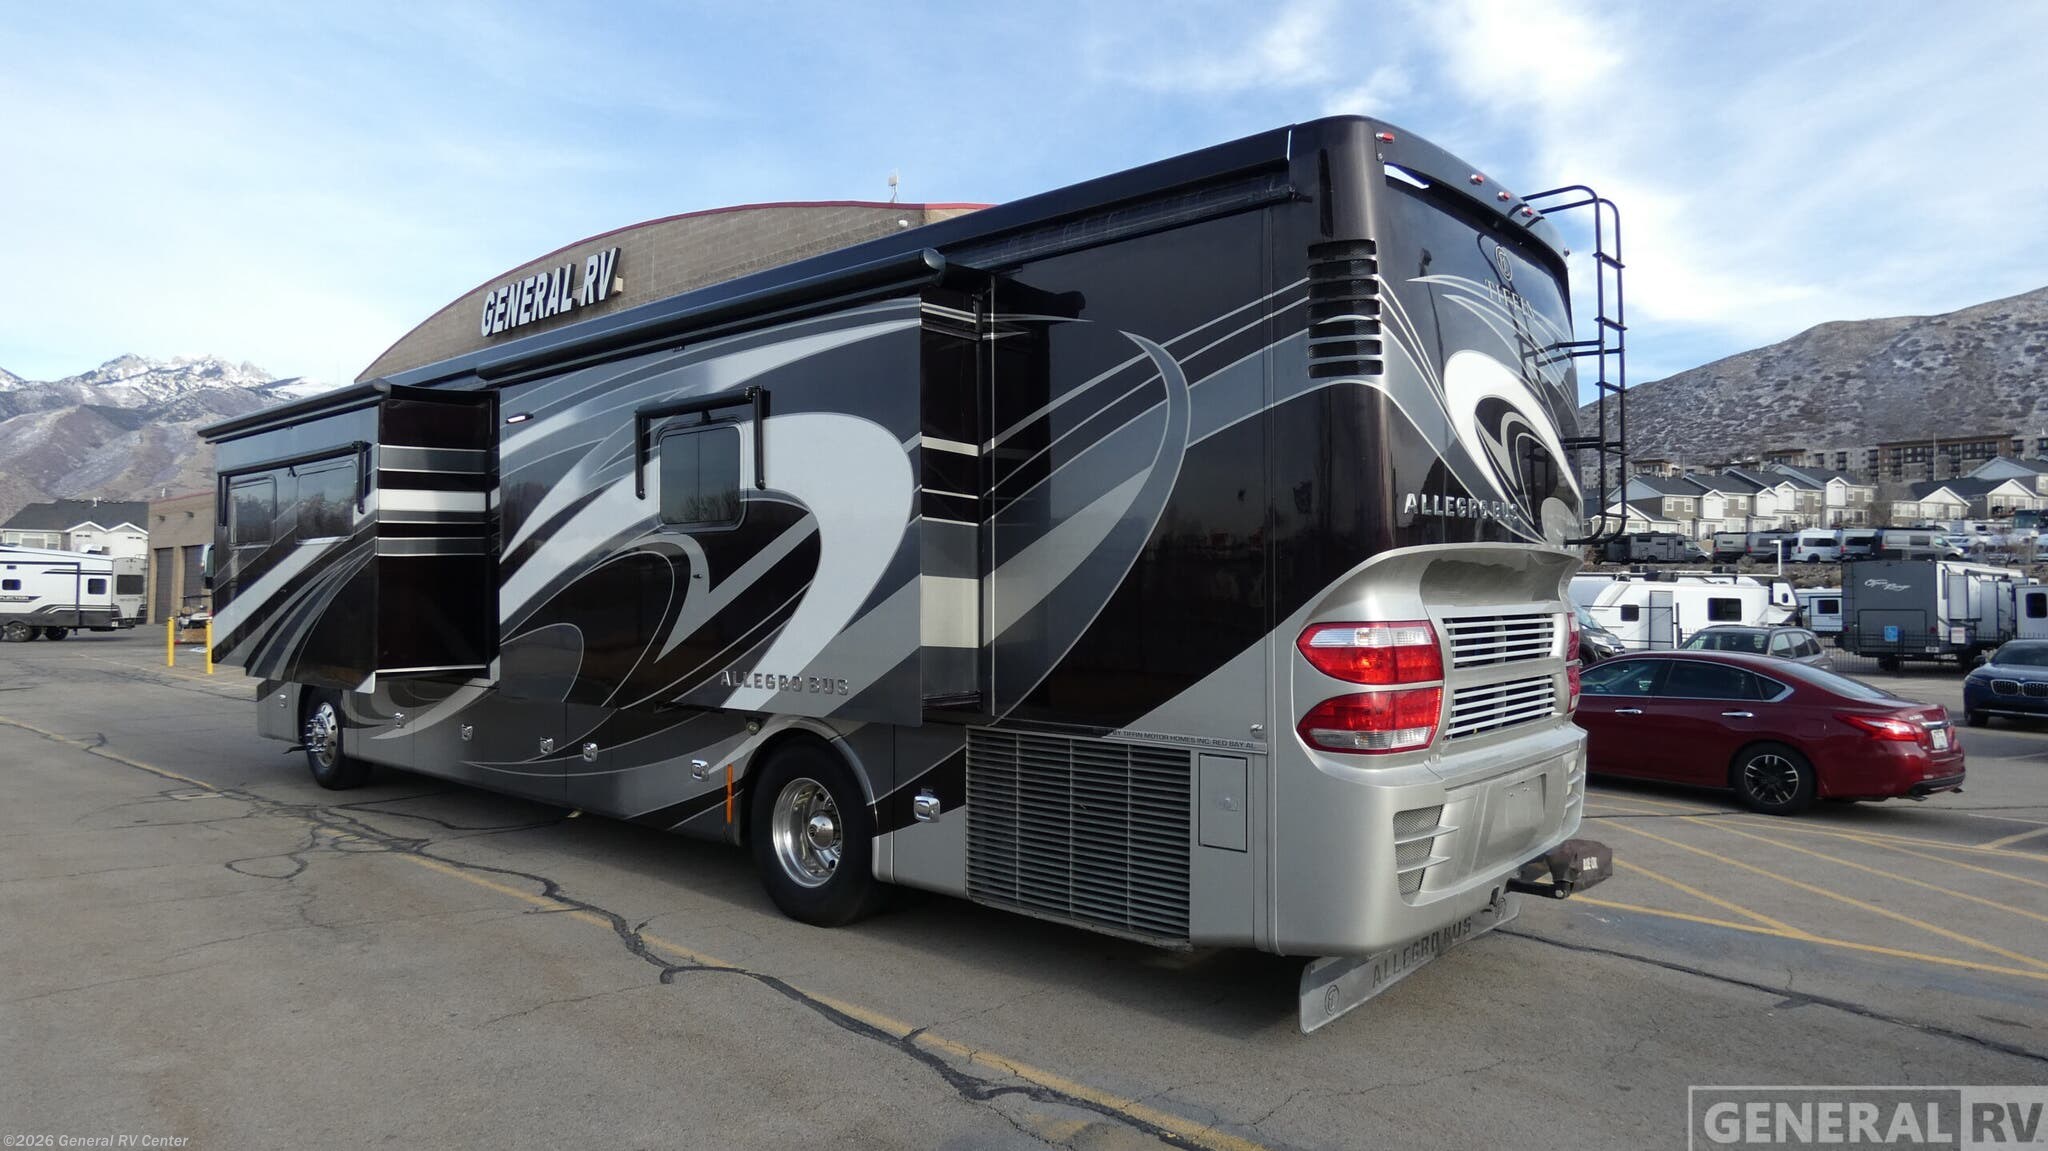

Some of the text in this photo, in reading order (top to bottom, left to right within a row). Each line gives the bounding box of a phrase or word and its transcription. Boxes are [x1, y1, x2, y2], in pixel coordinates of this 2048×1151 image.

[481, 247, 621, 337] GENERAL RV
[1404, 493, 1518, 521] ALLEGRO BUS
[720, 670, 849, 696] ALLEGRO BUS
[1144, 732, 1169, 740] MOTOR
[1170, 735, 1195, 744] HOMES
[1372, 931, 1441, 989] ALLEGRO
